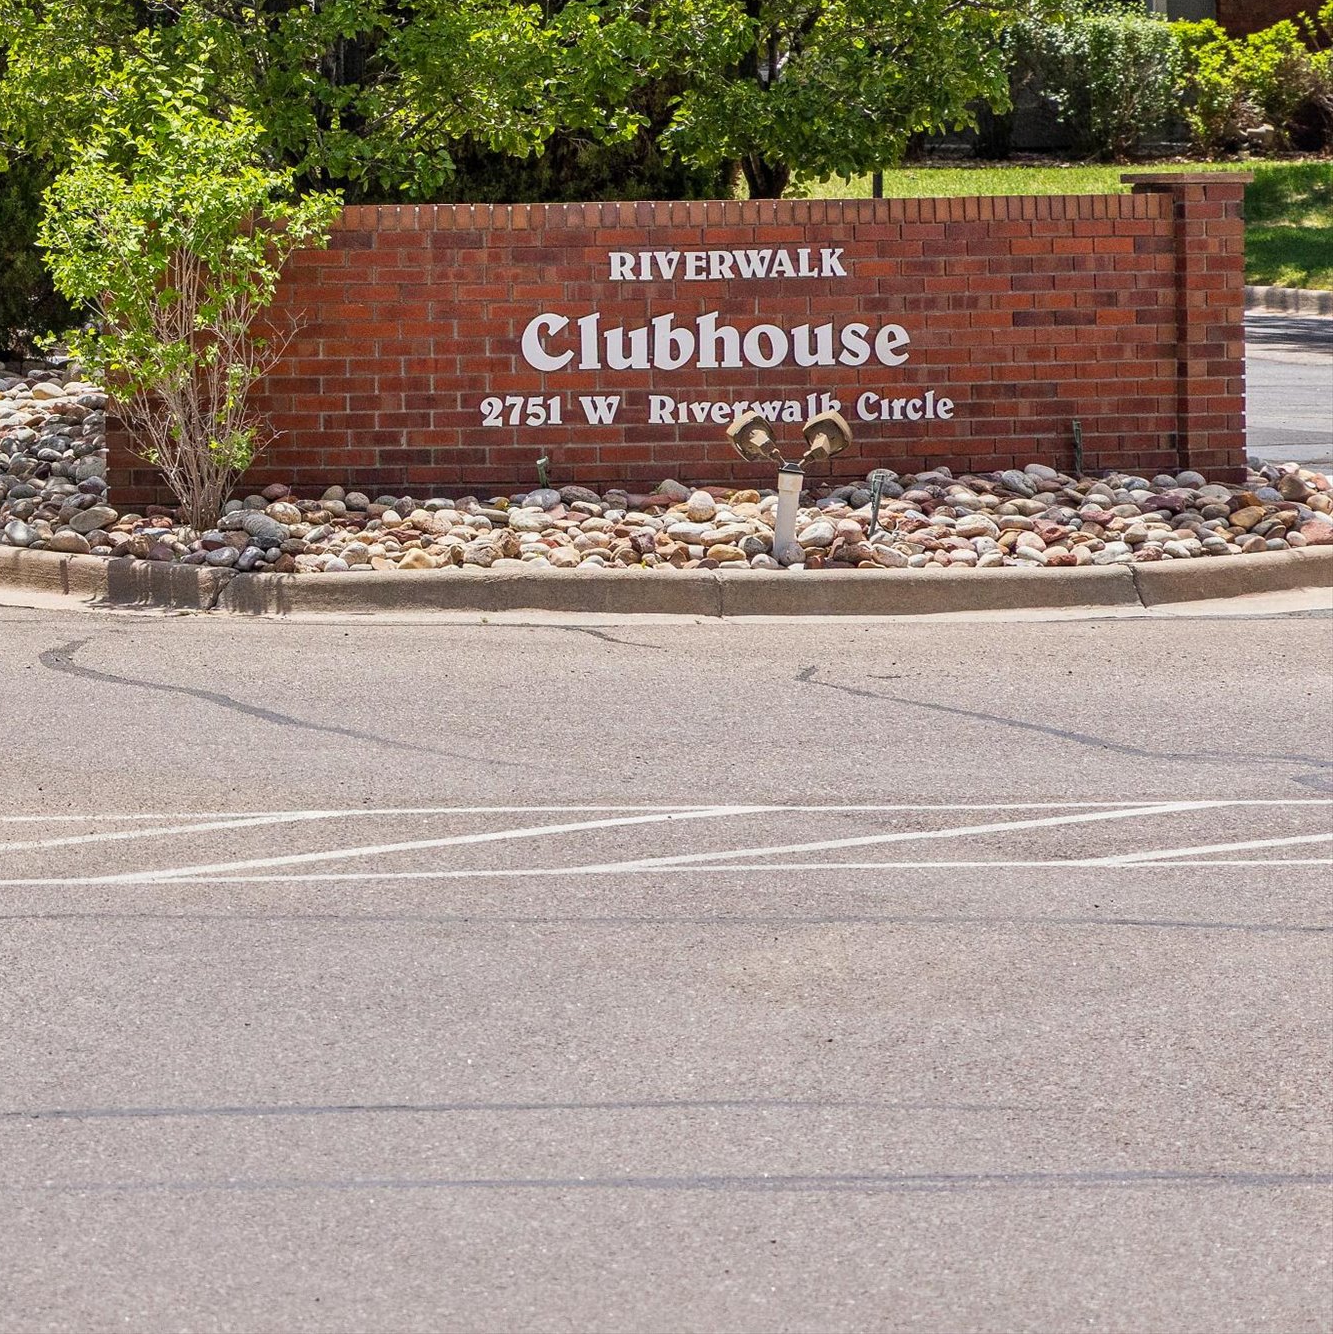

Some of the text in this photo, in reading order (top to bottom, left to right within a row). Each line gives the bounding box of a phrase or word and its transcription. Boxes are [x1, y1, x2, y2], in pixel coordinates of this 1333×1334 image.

[608, 248, 848, 281] RIVERWALK
[521, 310, 911, 372] Clubhouse
[479, 390, 955, 427] 2751 W Riverwalk Circle
